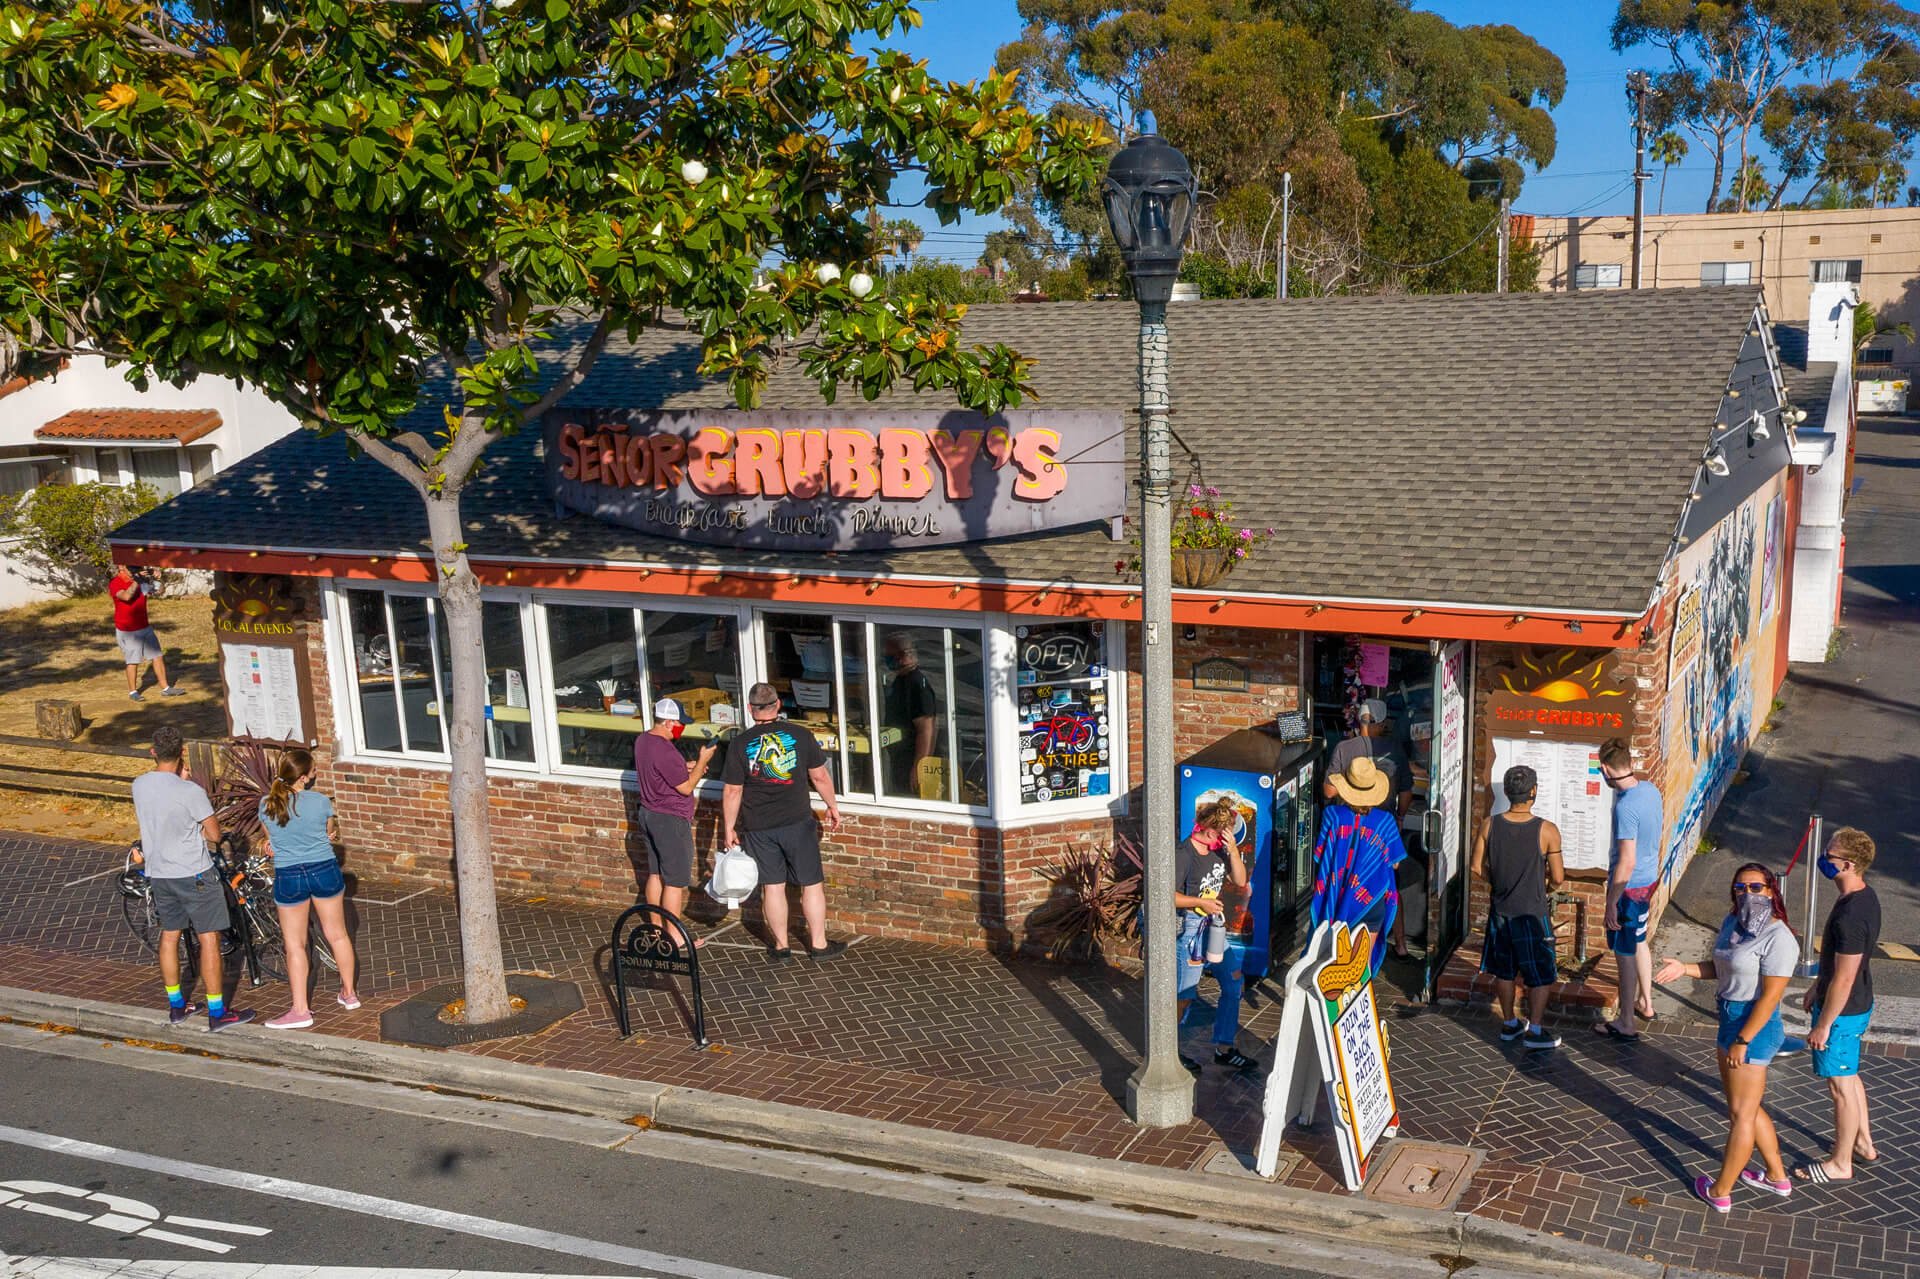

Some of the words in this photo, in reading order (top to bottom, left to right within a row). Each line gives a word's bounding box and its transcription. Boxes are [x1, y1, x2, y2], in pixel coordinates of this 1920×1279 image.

[557, 422, 687, 490] SEÑOR
[686, 425, 1069, 501] GRUBBY'S
[644, 500, 748, 533] Breakfast
[766, 502, 830, 536] Lunch
[851, 503, 942, 537] Dinner
[217, 616, 251, 634] LOCAL
[253, 622, 294, 635] EVENTS
[1025, 643, 1090, 667] OPEN
[1535, 708, 1624, 729] GRUBBY'S
[1027, 753, 1057, 769] AT
[1062, 751, 1099, 767] TIRE
[1342, 1008, 1359, 1038] JOIN
[1361, 994, 1369, 1013] US
[1347, 1033, 1357, 1054] ON
[1358, 1014, 1371, 1039] THE
[1353, 1035, 1372, 1067] BACK
[1355, 1051, 1376, 1089] PATIO
[1357, 1085, 1372, 1110] PATIO
[1372, 1070, 1382, 1086] BAR
[1362, 1089, 1383, 1120] SERVICE
